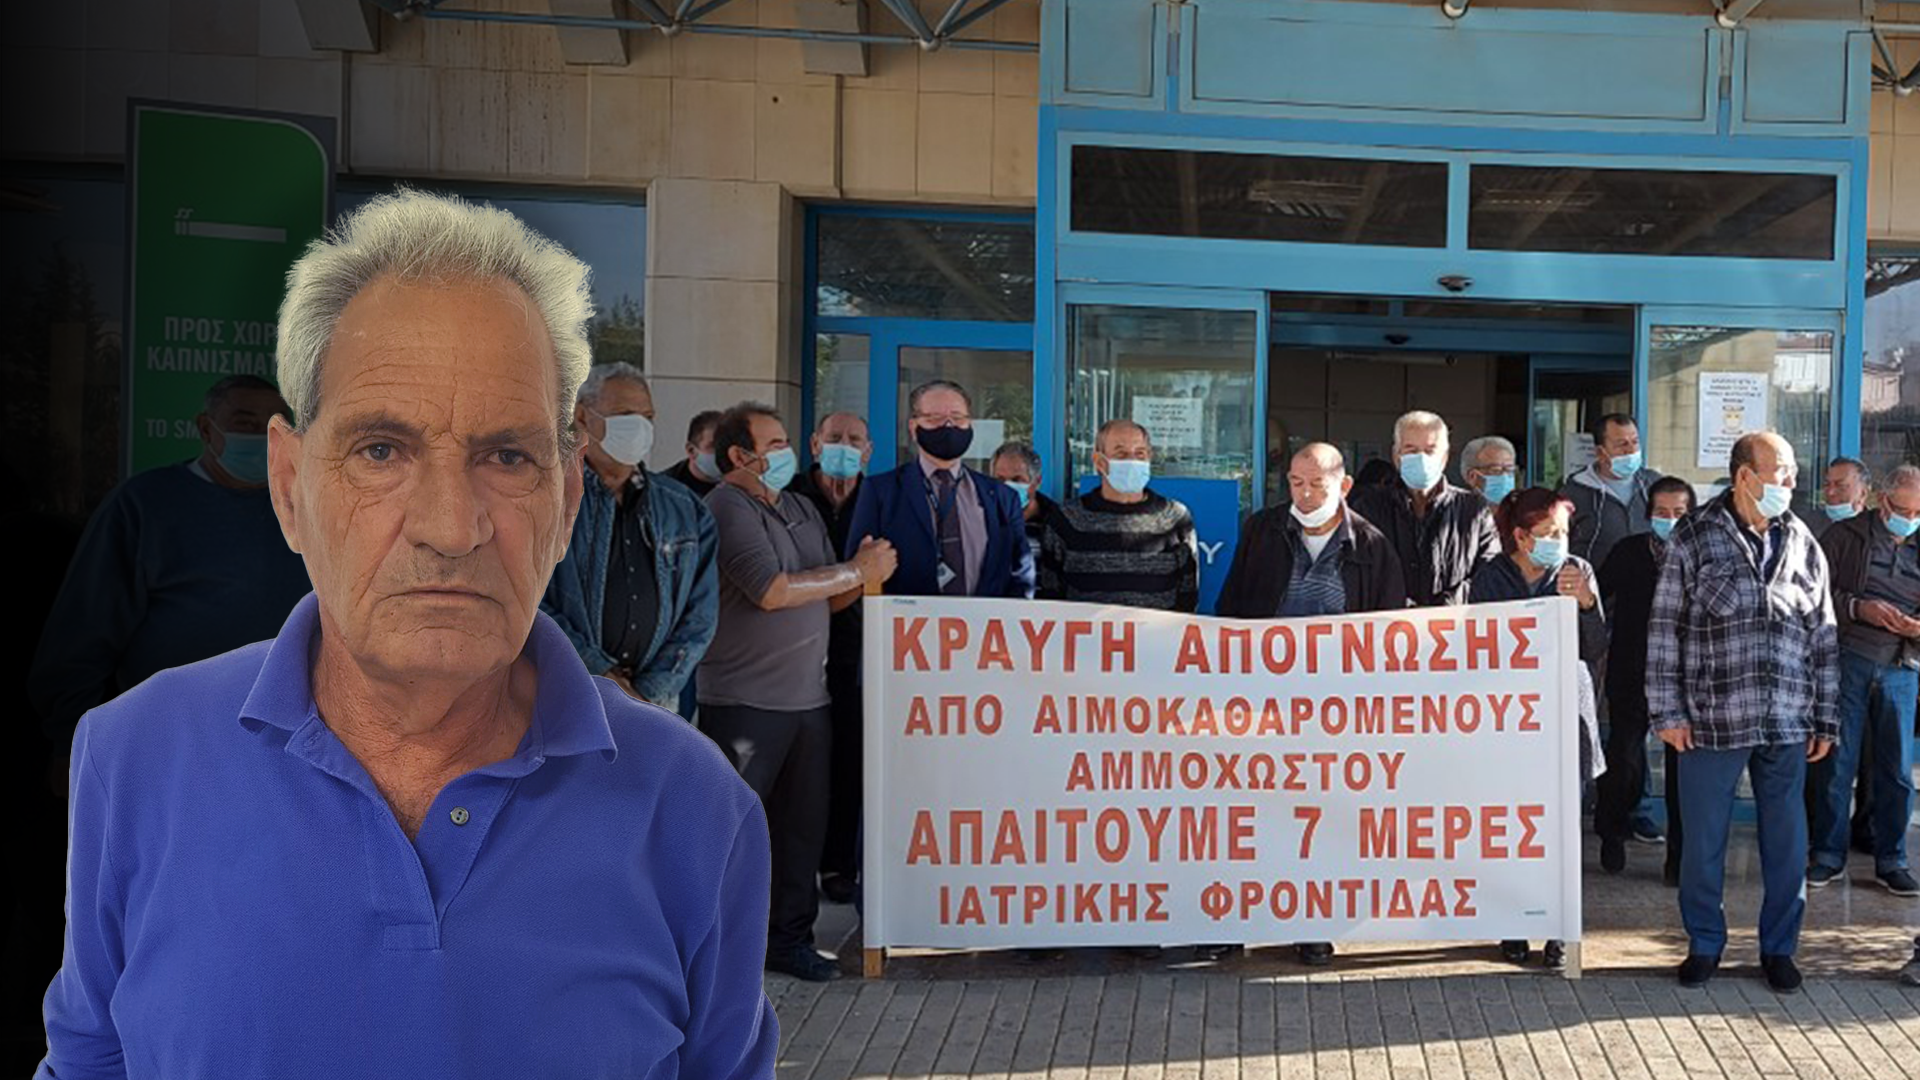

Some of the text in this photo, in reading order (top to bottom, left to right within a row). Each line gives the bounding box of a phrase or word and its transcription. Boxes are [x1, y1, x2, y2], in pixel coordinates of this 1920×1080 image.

[164, 315, 278, 346] ΠΡΟΣ ΧΩΡ
[147, 346, 278, 376] ΚΑΠΝΙΣΜΑΤ
[174, 419, 202, 440] SM
[893, 616, 1539, 674] ΚΡΑΥΓΗ ΑΠΟΓΝΩΣΗΣ
[904, 693, 1541, 736] ΑΠΟ ΑΙΜΟΚΑΘΑΡΟΜΕΝΟΥΣ
[1066, 751, 1405, 792] ΑΜΜΟΧΩΣΤΟΥ
[906, 804, 1545, 866] ΑΠΑΙΤΟΥΜΕ 7 ΜΕΡΕΣ
[939, 878, 1477, 925] ΙΑΤΡΙΚΗΣ ΦΡΟΝΤΙΔΑΣ
